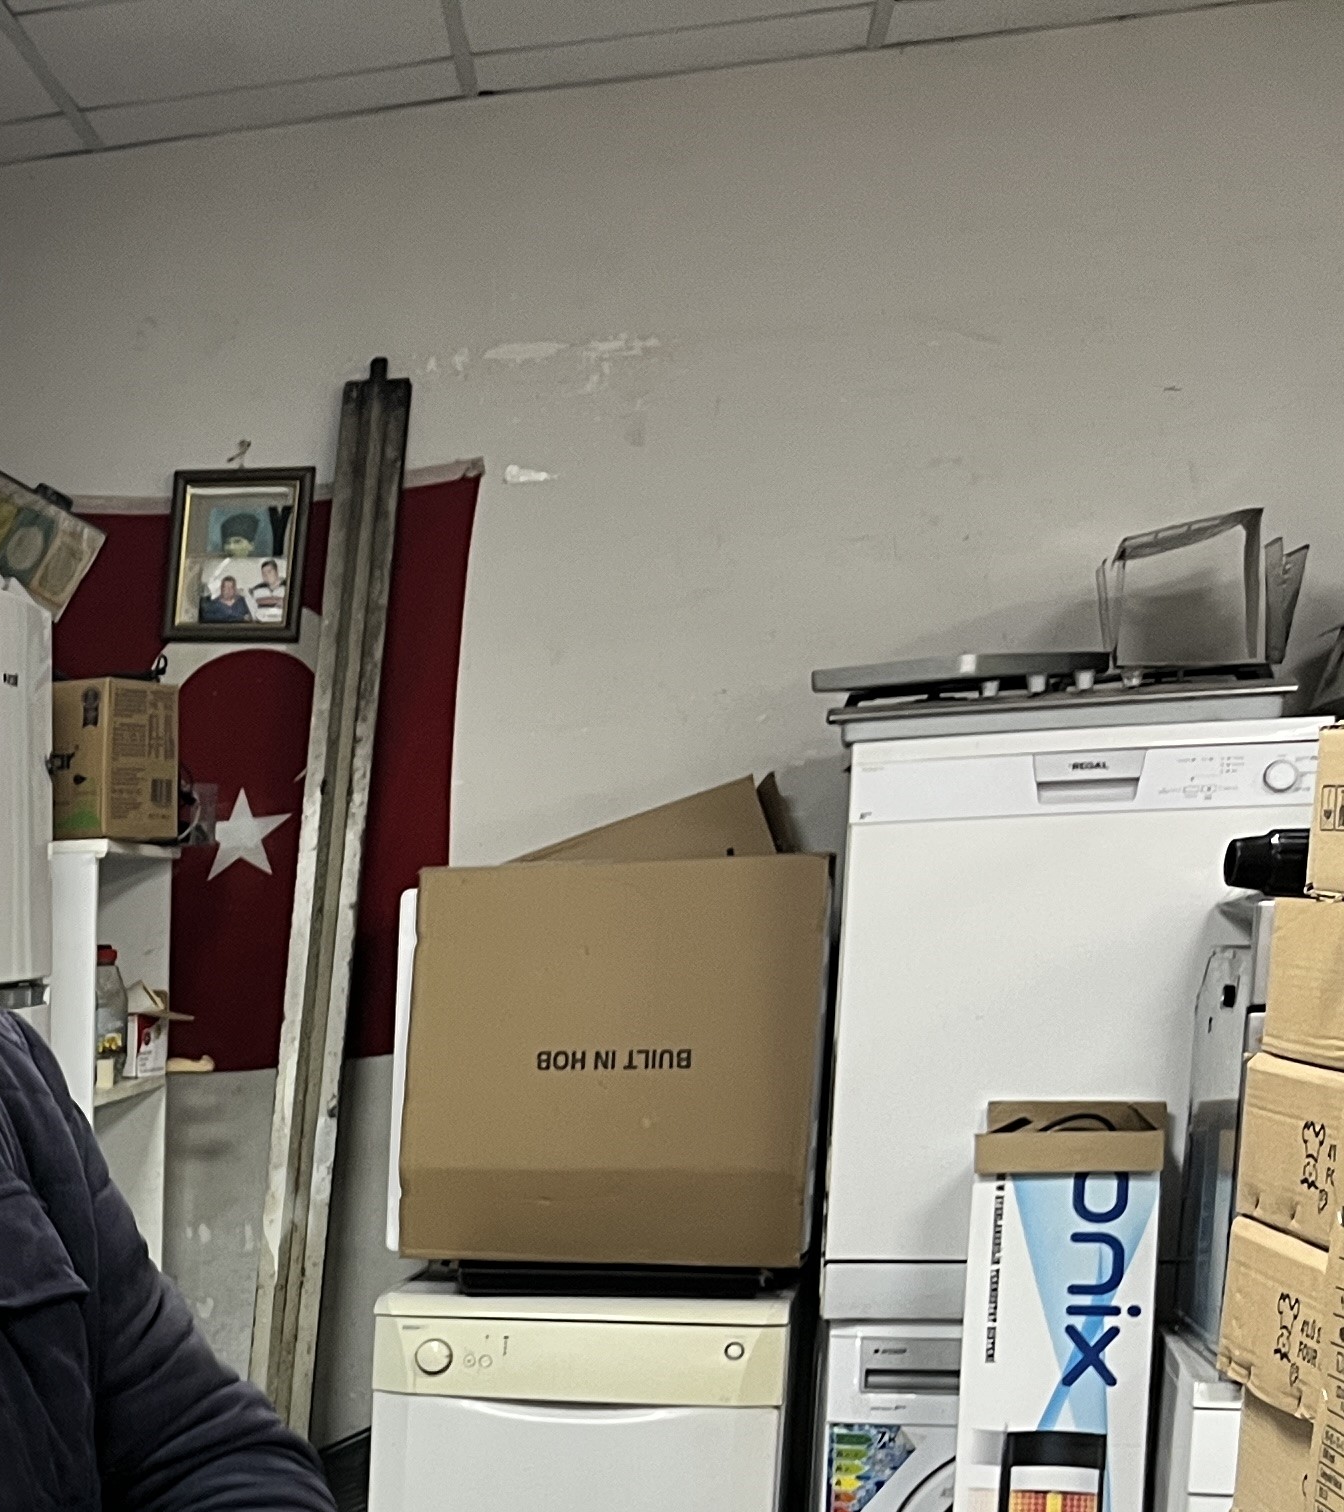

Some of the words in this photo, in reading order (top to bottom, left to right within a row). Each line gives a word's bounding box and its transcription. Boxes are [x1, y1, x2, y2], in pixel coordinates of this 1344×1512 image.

[1071, 760, 1109, 771] REGAL
[537, 1050, 586, 1070] HOB
[593, 1050, 616, 1070] IN
[623, 1049, 692, 1070] BUILT
